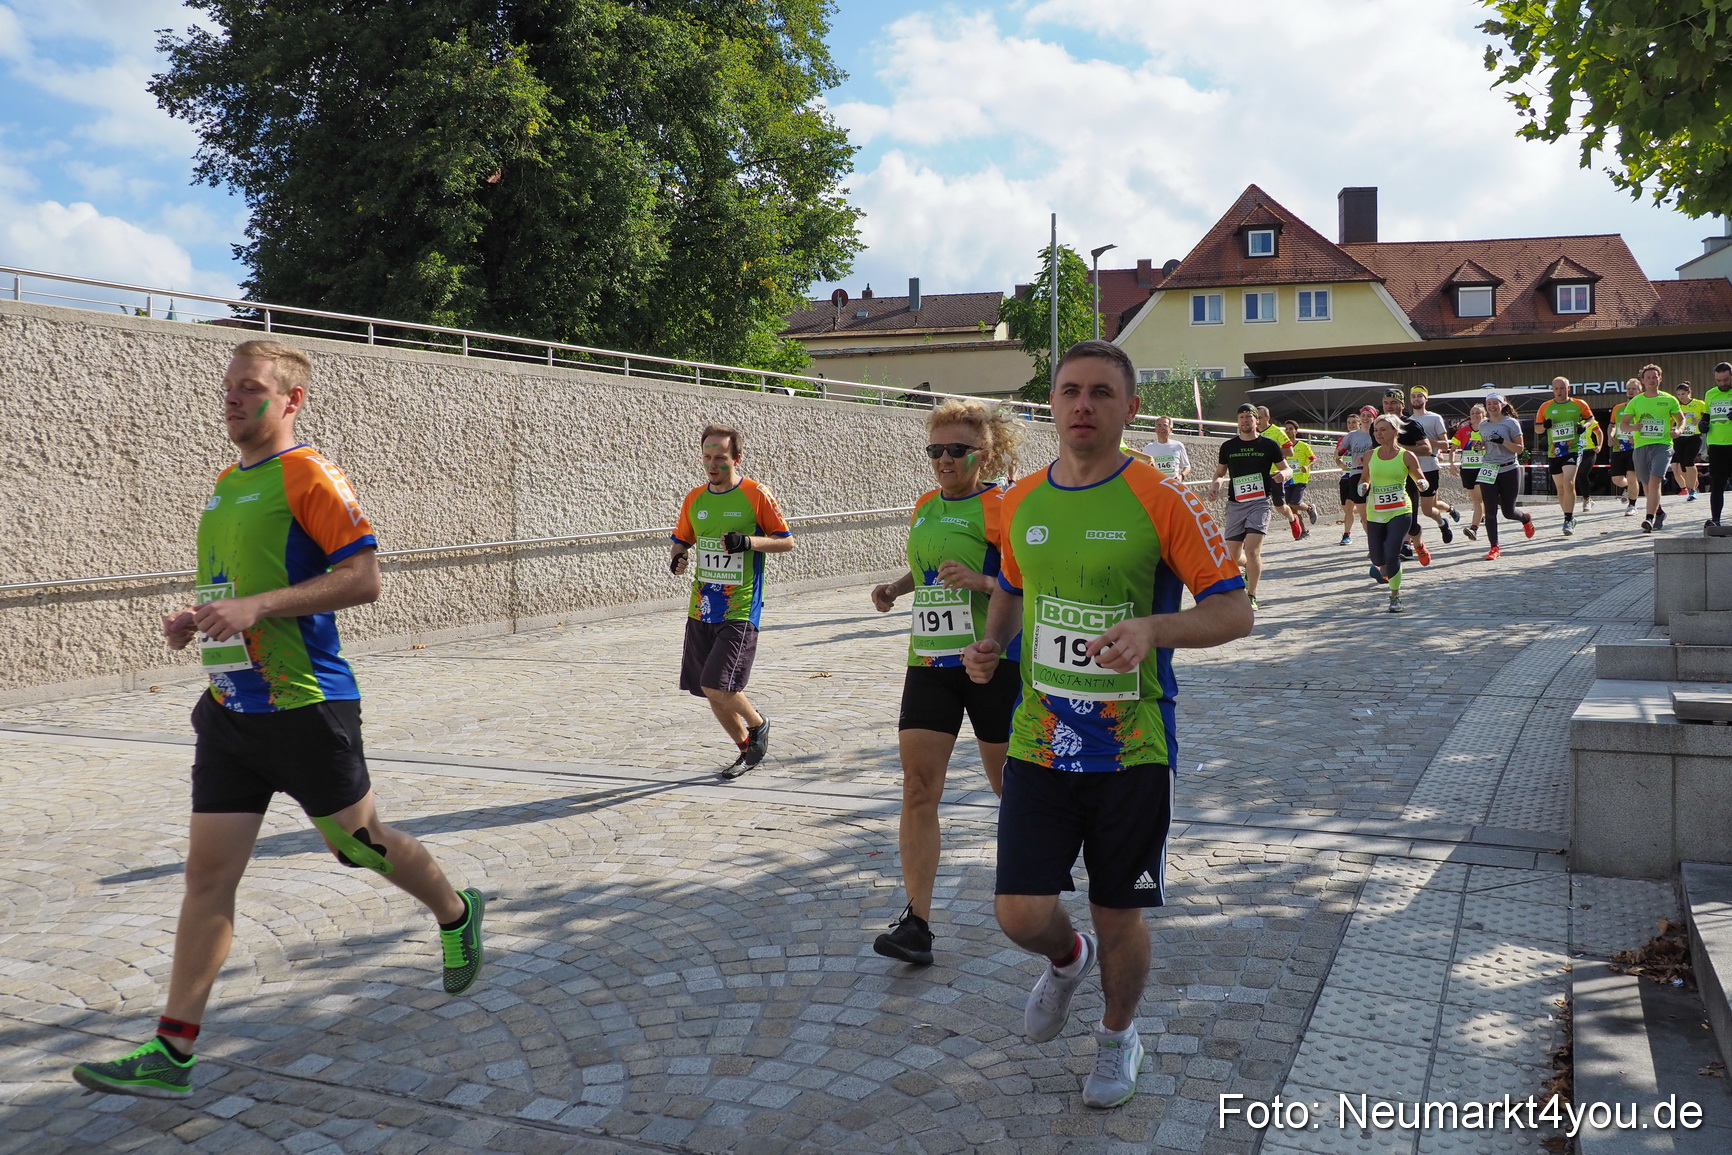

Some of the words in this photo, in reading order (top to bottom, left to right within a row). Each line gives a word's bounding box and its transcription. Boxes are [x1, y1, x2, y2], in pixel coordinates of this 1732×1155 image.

[1713, 406, 1727, 414] 194
[1555, 427, 1570, 436] 187
[1157, 461, 1171, 469] 146
[1240, 483, 1259, 494] 534
[1378, 492, 1399, 504] 535
[1159, 476, 1232, 568] BOCK
[1085, 530, 1127, 541] BOCK
[704, 553, 732, 569] 117
[701, 570, 737, 580] BENJAMIN
[1041, 599, 1127, 632] BOCK
[918, 610, 954, 633] 191
[1053, 634, 1116, 669] 19
[1039, 667, 1116, 688] CONSTANTIN
[1133, 882, 1157, 890] adidas
